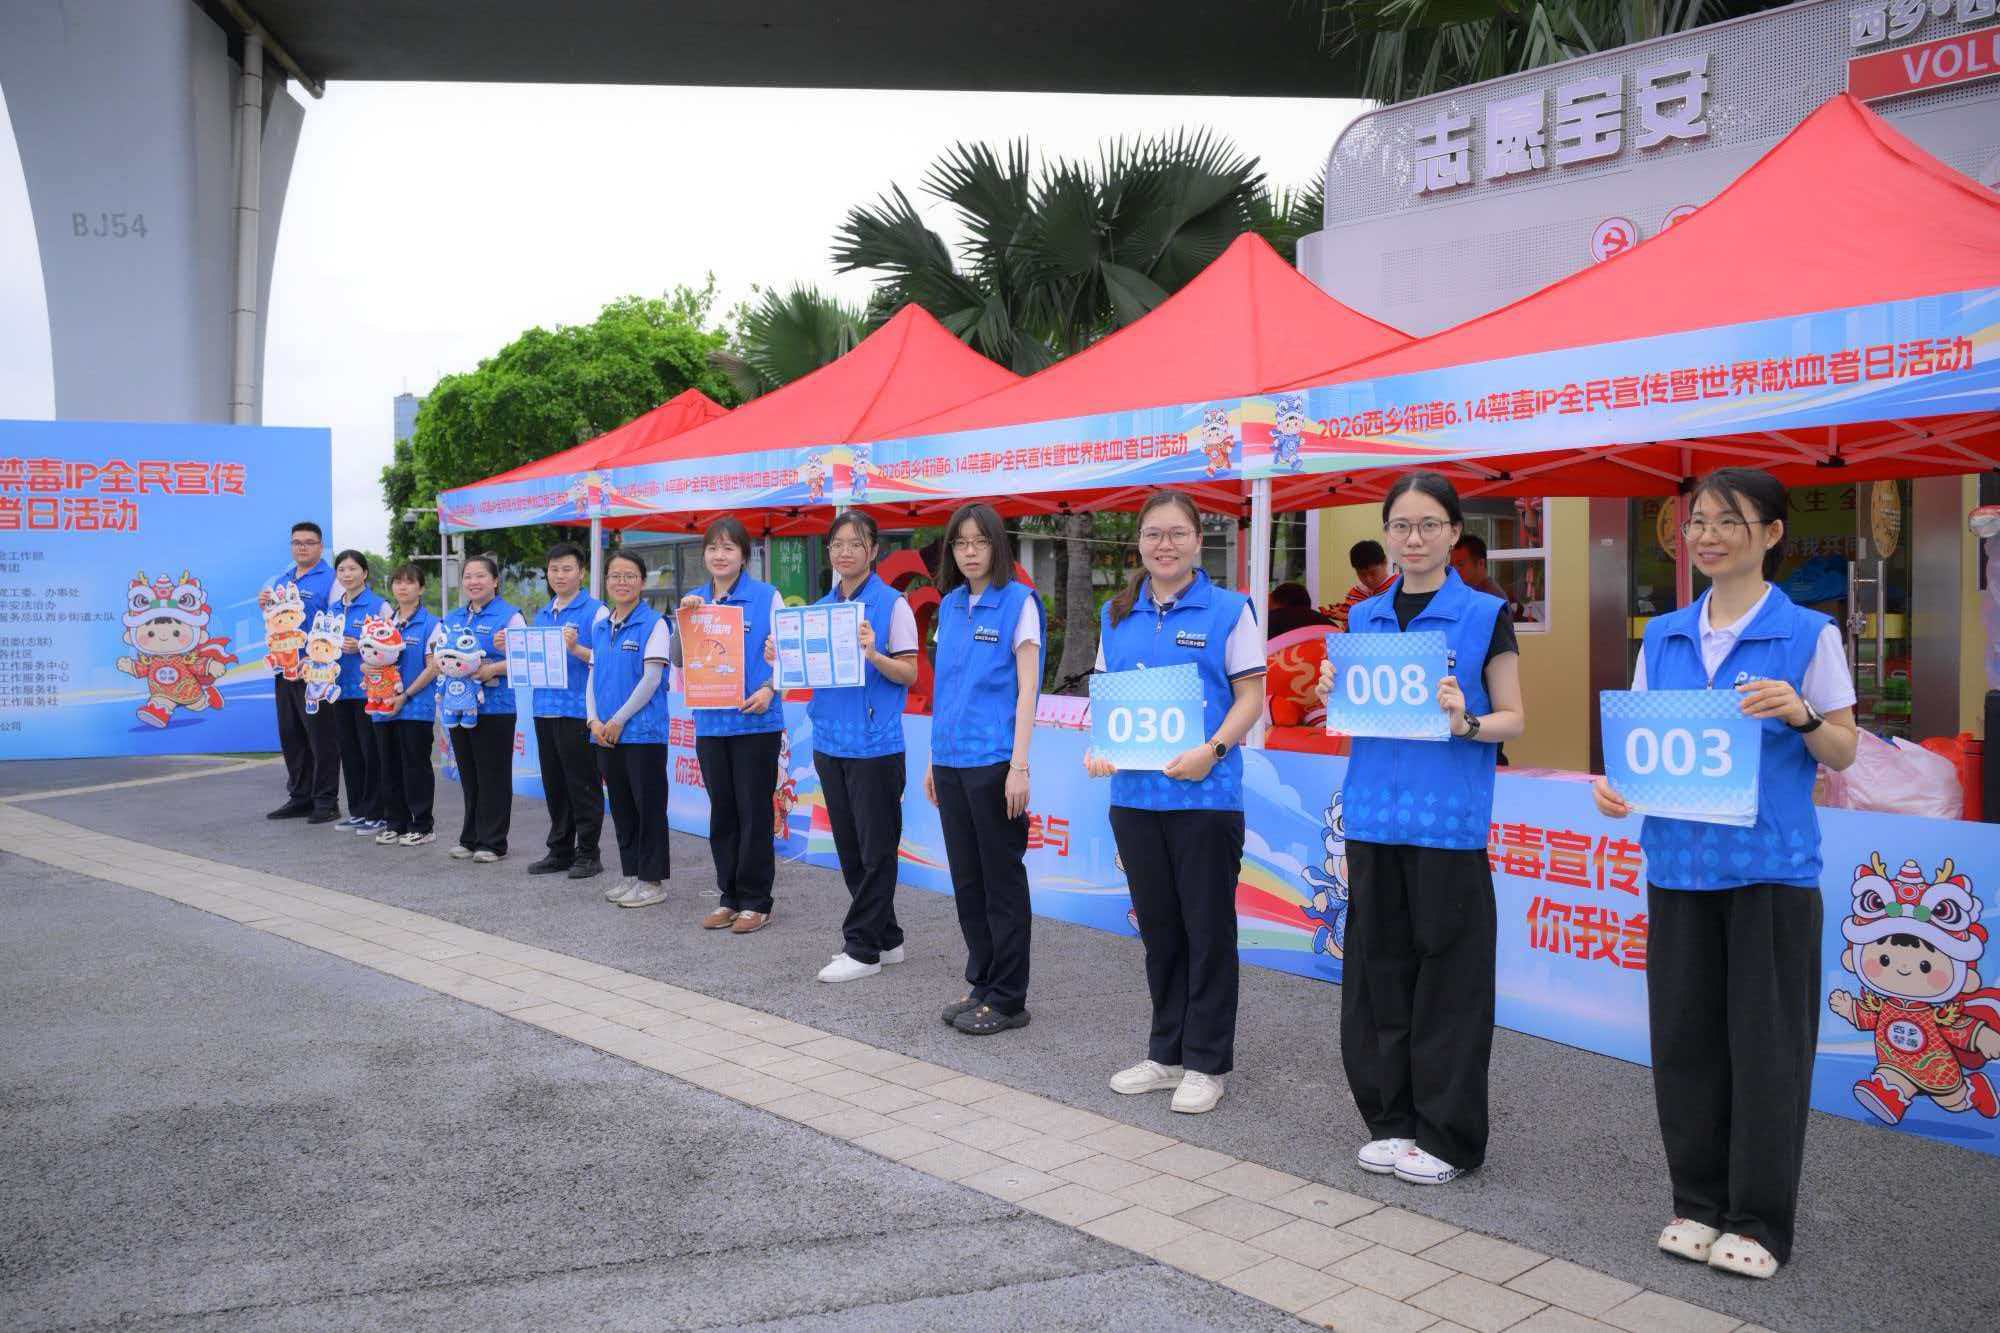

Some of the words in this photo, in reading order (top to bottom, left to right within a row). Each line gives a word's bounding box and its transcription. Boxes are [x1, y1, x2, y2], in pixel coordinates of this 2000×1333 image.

[1414, 54, 1708, 193] 志愿宝安
[72, 212, 149, 239] BJ54
[1317, 335, 1973, 440] 2026西乡街道6.14禁毒IP全民宣传暨世界献血者日活动
[1346, 663, 1429, 706] 008
[1107, 706, 1187, 743] 030
[1624, 727, 1732, 777] 003
